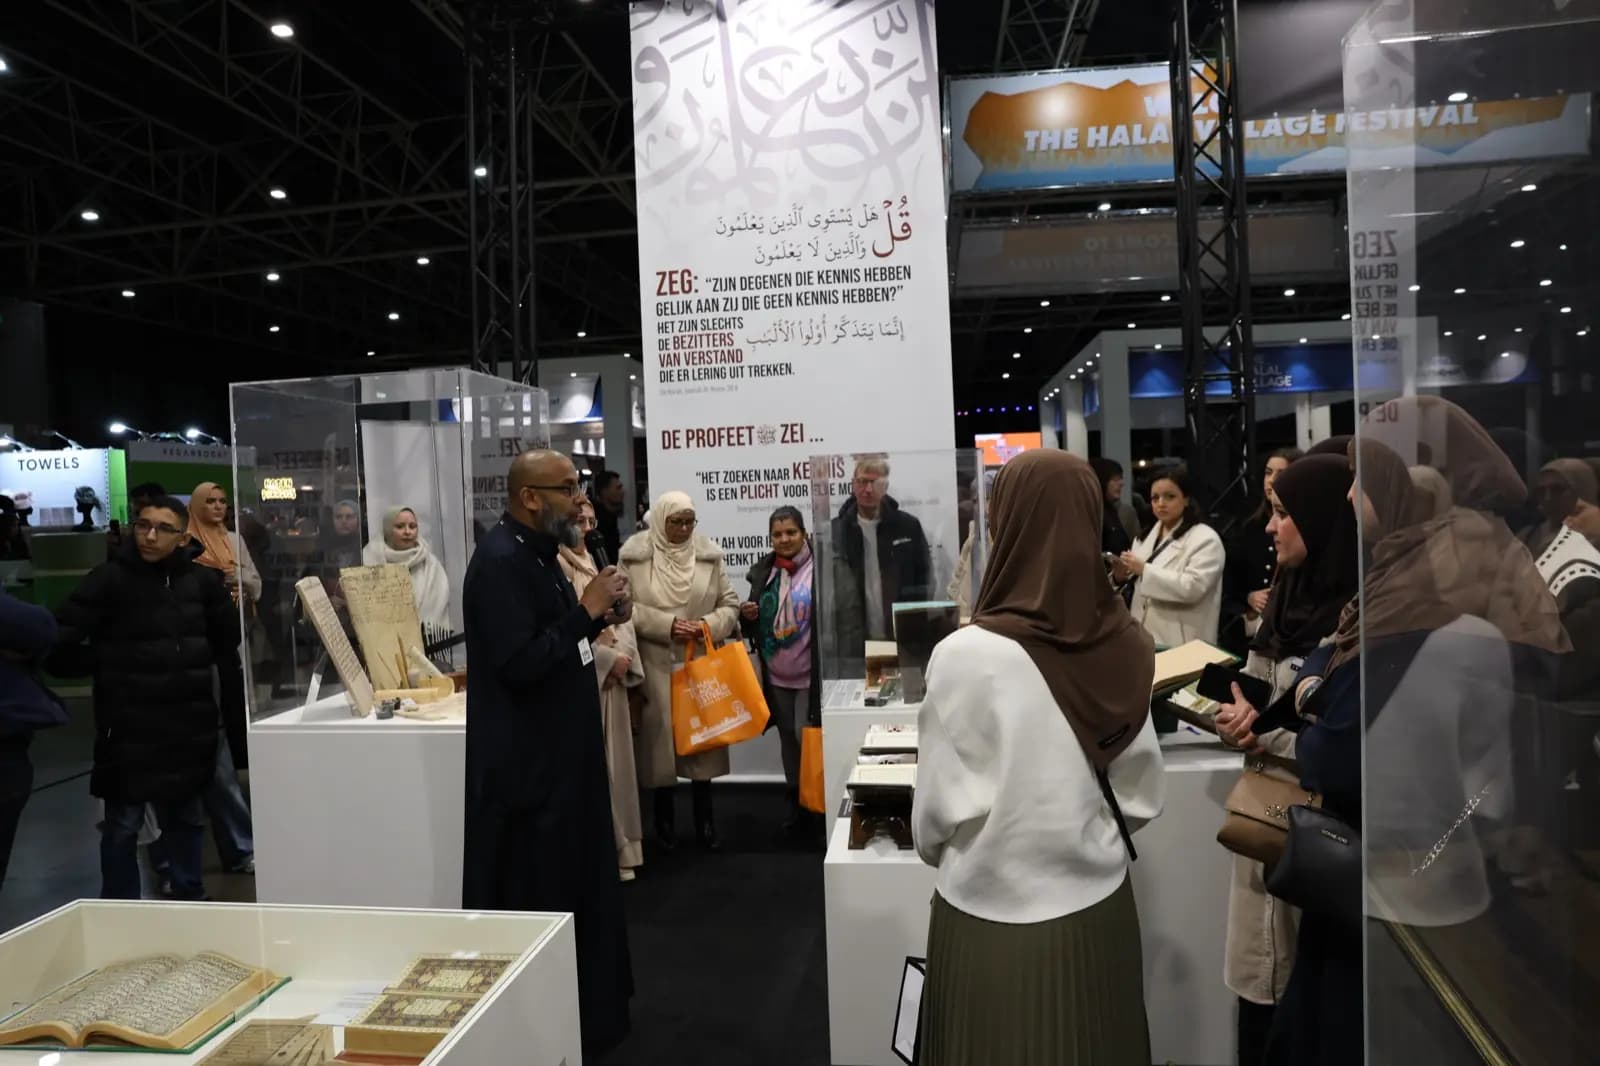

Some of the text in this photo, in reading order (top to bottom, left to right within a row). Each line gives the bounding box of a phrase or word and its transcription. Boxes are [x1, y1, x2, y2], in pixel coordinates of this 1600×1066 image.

[1024, 103, 1479, 152] THE HALA VLAGE FESTIVAL
[656, 269, 699, 297] ZEG:
[740, 272, 793, 292] DEGENEN
[796, 271, 813, 287] DIE
[817, 268, 862, 285] KENNIS
[864, 265, 912, 282] HEBBEN
[656, 298, 693, 317] GELIJK
[696, 297, 719, 314] AAN
[723, 296, 739, 312] ZIJ
[742, 294, 761, 311] DIE
[763, 292, 793, 310] GEEN
[796, 289, 840, 308] KENNIS
[657, 316, 744, 334] HET ZIJN SLECHTS
[658, 332, 735, 351] DE BEZITTERS
[659, 348, 744, 368] VAN VERSTAND
[659, 362, 795, 383] DIE ER LERING UIT TREKKEN.
[661, 430, 681, 450] DE
[686, 425, 755, 449] PROFEET
[780, 423, 805, 444] ZEI
[17, 456, 80, 471] TOWELS
[723, 468, 761, 483] ZOEKEN
[763, 467, 790, 482] NAAR
[706, 488, 717, 501] IS
[718, 487, 738, 501] EEN
[740, 483, 780, 500] PLICHT
[782, 484, 809, 498] VOOR
[738, 535, 764, 549] VOOR
[723, 552, 755, 567] HENKT
